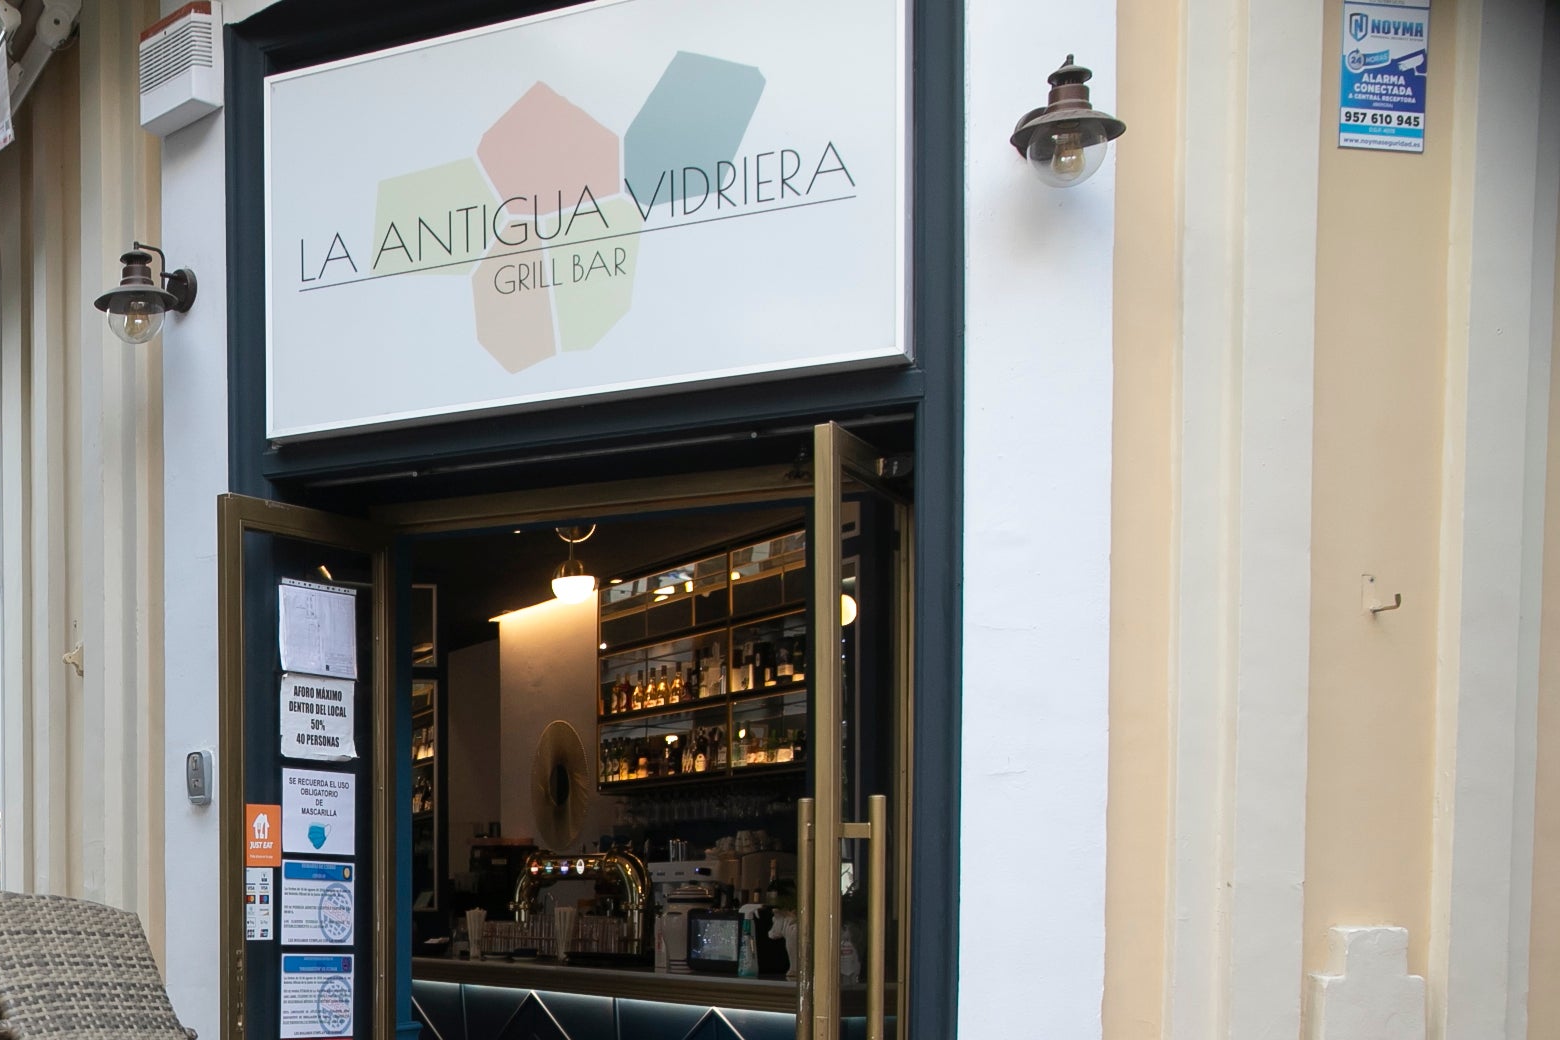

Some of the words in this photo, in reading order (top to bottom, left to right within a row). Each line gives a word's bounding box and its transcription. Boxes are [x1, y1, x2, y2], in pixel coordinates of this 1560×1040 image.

[1371, 19, 1424, 37] NOYMA
[1351, 56, 1362, 65] 24
[1366, 53, 1388, 64] HORAS
[1362, 73, 1406, 85] ALARMA
[1354, 83, 1413, 96] CONECTADA
[1354, 93, 1380, 101] CENTRAL
[1382, 96, 1417, 104] RECEPTORA
[1344, 111, 1367, 123] 957
[1371, 113, 1393, 125] 610
[1396, 115, 1420, 127] 945
[1343, 138, 1421, 148] www.noymaseguridad.es
[299, 231, 358, 283] LA
[373, 185, 609, 270] ANTIGUA
[623, 141, 857, 223] VIDRIERA
[492, 256, 564, 296] GRILL
[572, 247, 628, 285] BAR
[293, 685, 315, 699] AFORO
[315, 686, 343, 702] MÁXIMO
[288, 700, 314, 715] DENTRO
[315, 703, 326, 716] DEL
[327, 705, 347, 718] LOCAL
[310, 718, 326, 731] 50%
[296, 733, 306, 745] 40
[306, 733, 340, 748] PERSONAS
[288, 777, 297, 785] SE
[297, 777, 329, 788] RECUERDA
[329, 781, 337, 789] EL
[337, 781, 350, 790] USO
[300, 788, 339, 798] OBLIGATORIO
[301, 807, 338, 817] MASCARILLA
[249, 841, 263, 850] JUST
[262, 841, 274, 849] EAT
